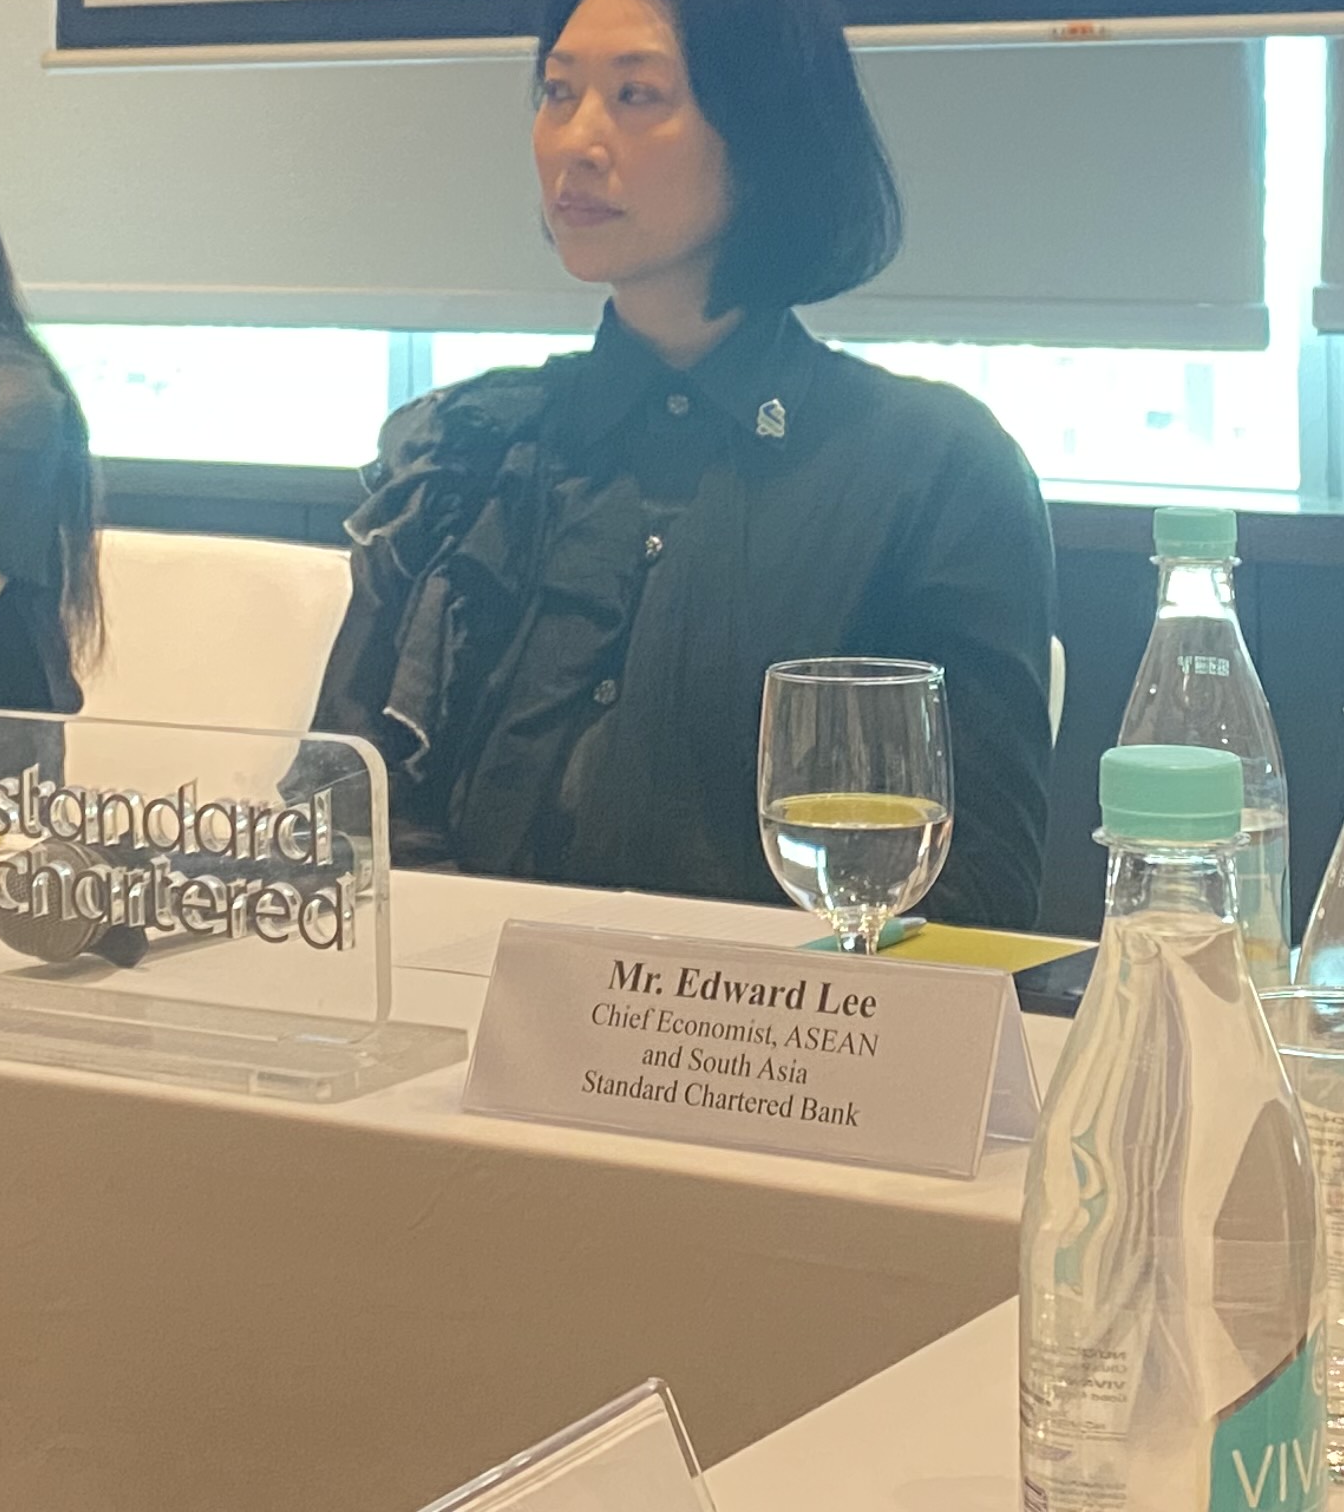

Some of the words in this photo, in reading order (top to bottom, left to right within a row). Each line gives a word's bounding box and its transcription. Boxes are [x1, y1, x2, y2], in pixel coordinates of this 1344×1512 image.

[608, 959, 663, 997] Mr.
[675, 966, 806, 1011] Edward
[816, 981, 877, 1018] Lee
[591, 1002, 656, 1032] Chief
[656, 1010, 778, 1049] Economist,
[784, 1025, 880, 1058] ASEAN
[642, 1047, 682, 1071] and
[687, 1048, 752, 1078] South
[757, 1058, 808, 1086] Asia
[581, 1069, 677, 1104] Standard
[683, 1083, 793, 1119] Chartered
[800, 1097, 860, 1128] Bank
